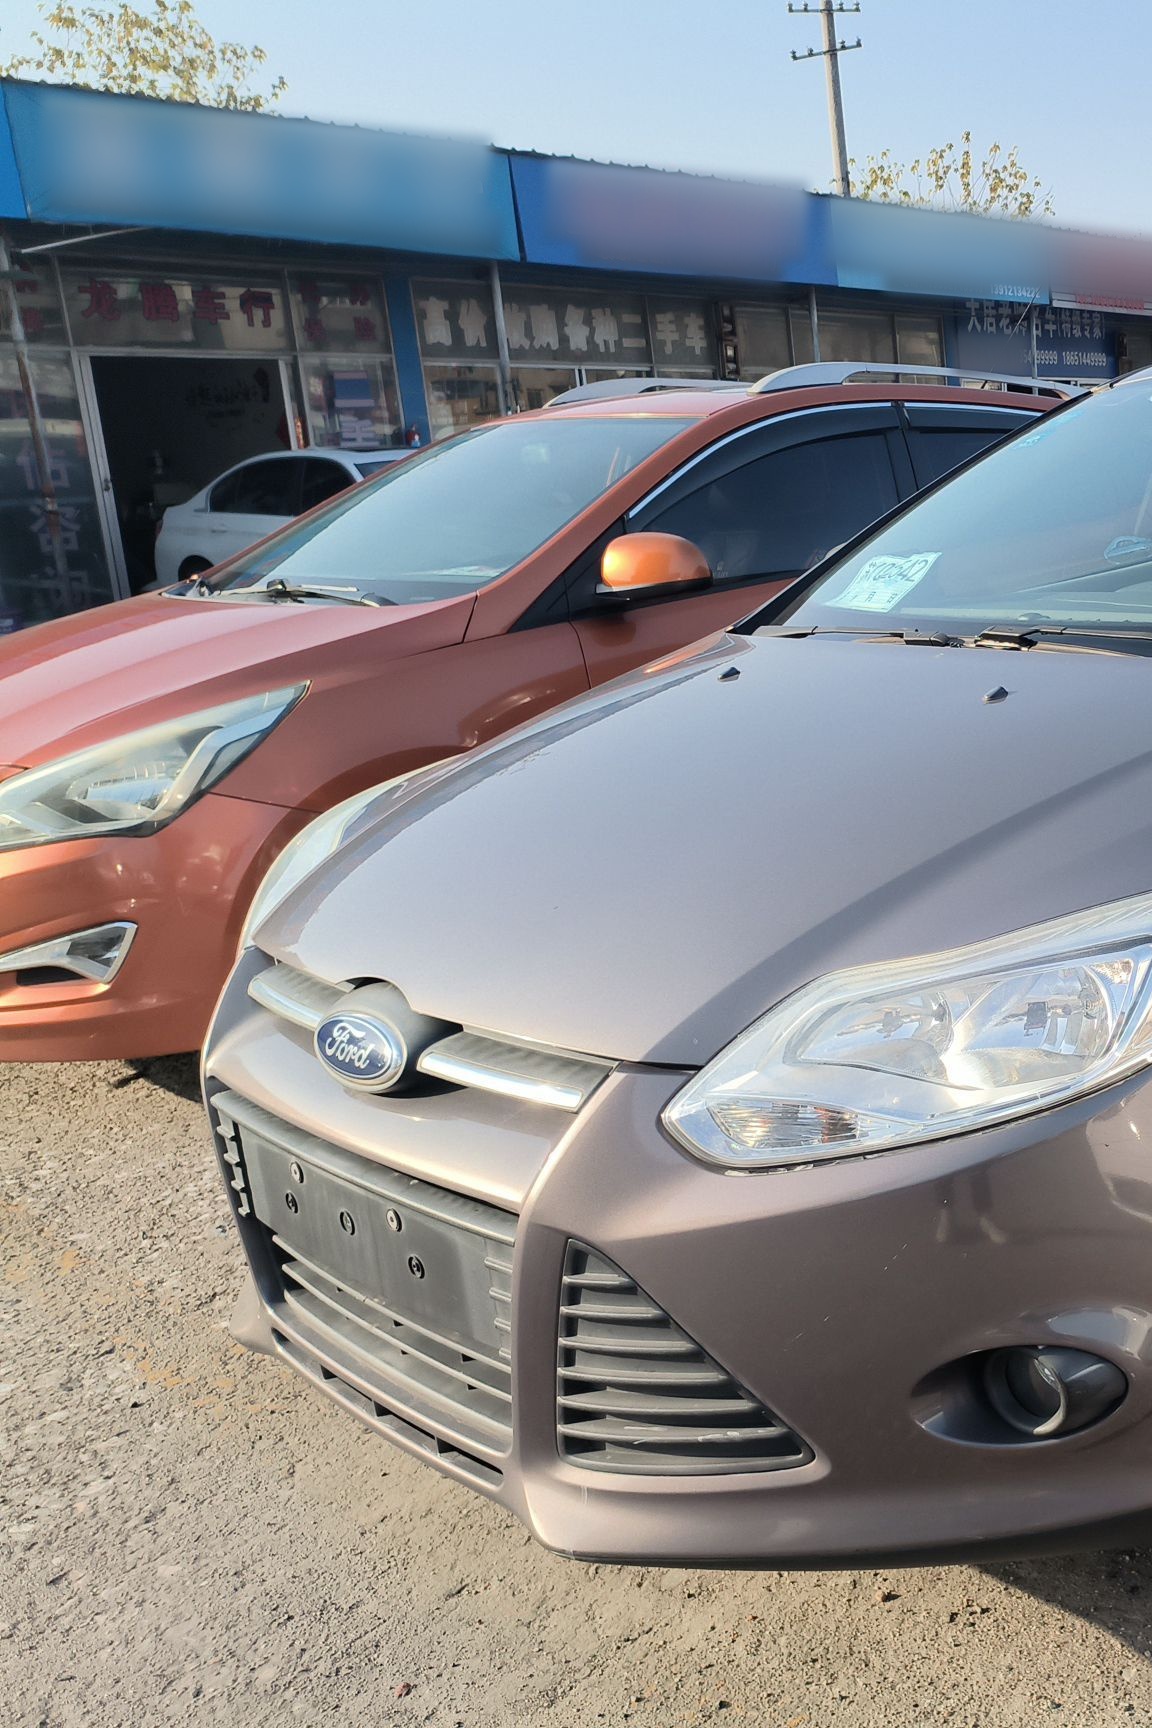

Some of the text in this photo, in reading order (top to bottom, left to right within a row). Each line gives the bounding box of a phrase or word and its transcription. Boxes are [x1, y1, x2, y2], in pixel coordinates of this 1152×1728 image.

[78, 280, 275, 328] 龙腾车行
[325, 1022, 375, 1069] Ford
